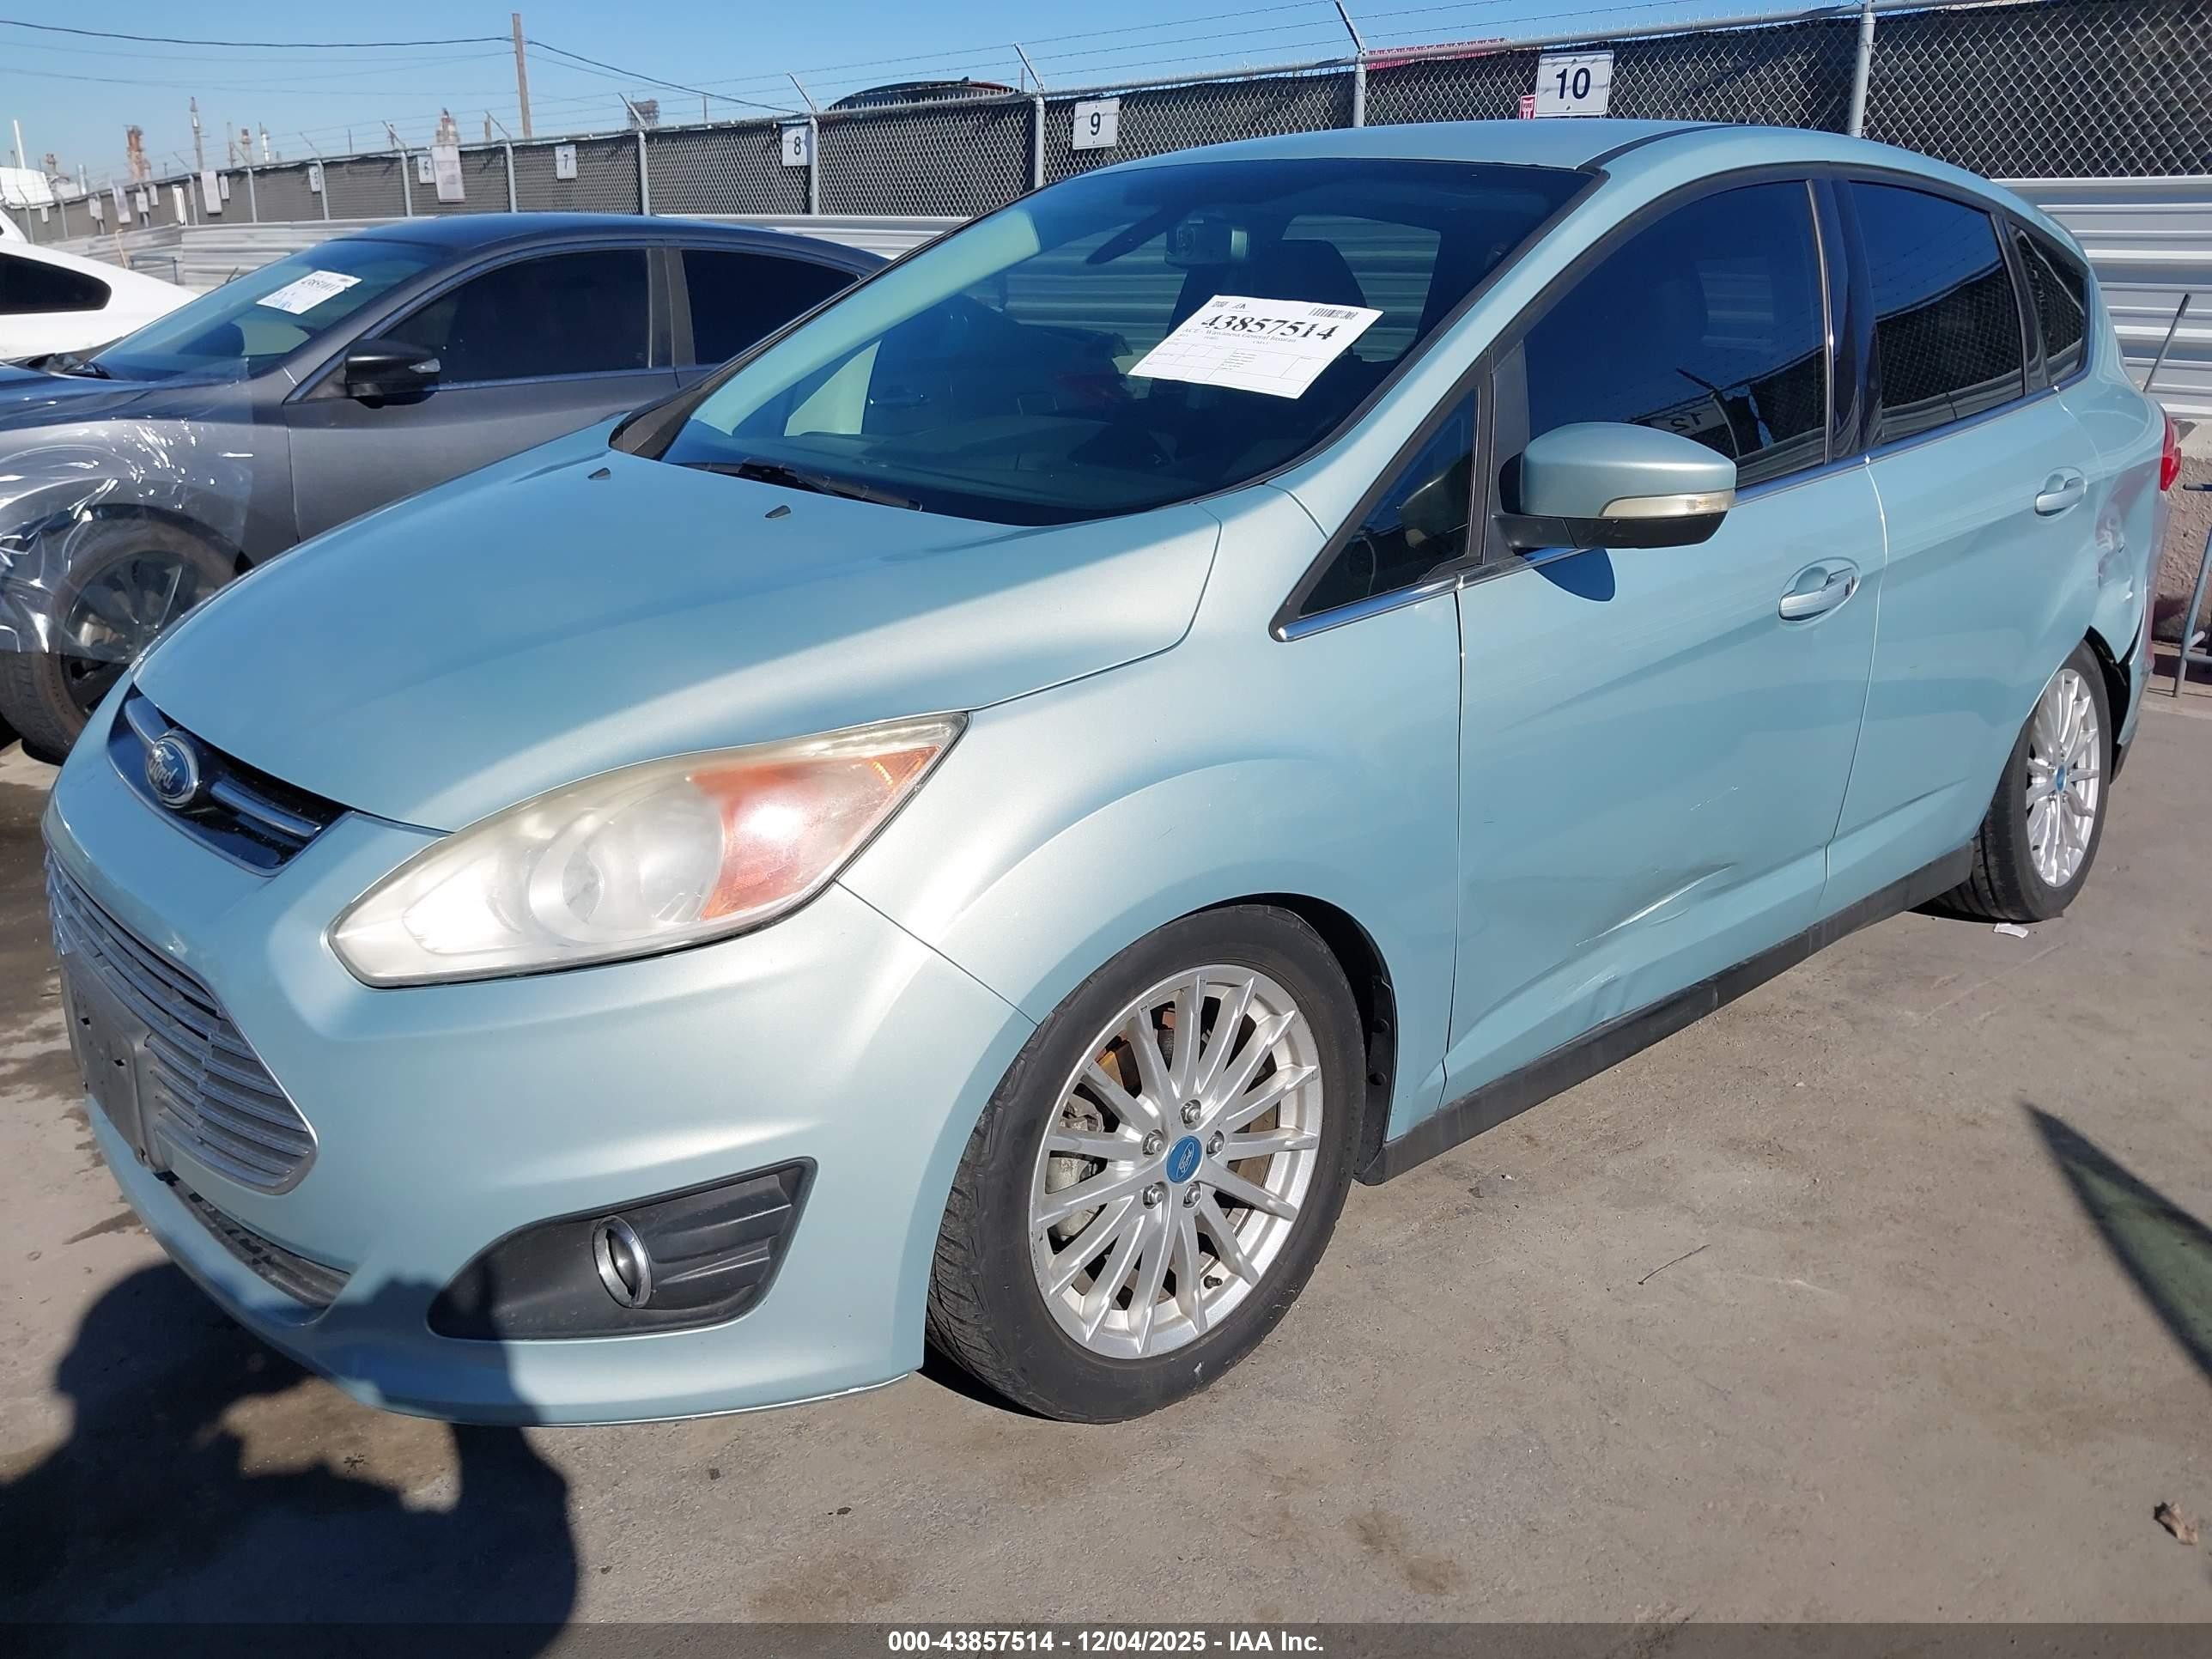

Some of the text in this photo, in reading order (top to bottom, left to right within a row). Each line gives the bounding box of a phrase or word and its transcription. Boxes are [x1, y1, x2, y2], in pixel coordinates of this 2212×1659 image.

[1555, 67, 1591, 100] 10
[1090, 112, 1101, 136] 9
[793, 136, 801, 155] 8
[563, 154, 568, 170] 7
[1200, 314, 1340, 340] 43857514
[1179, 1147, 1193, 1174] Ford
